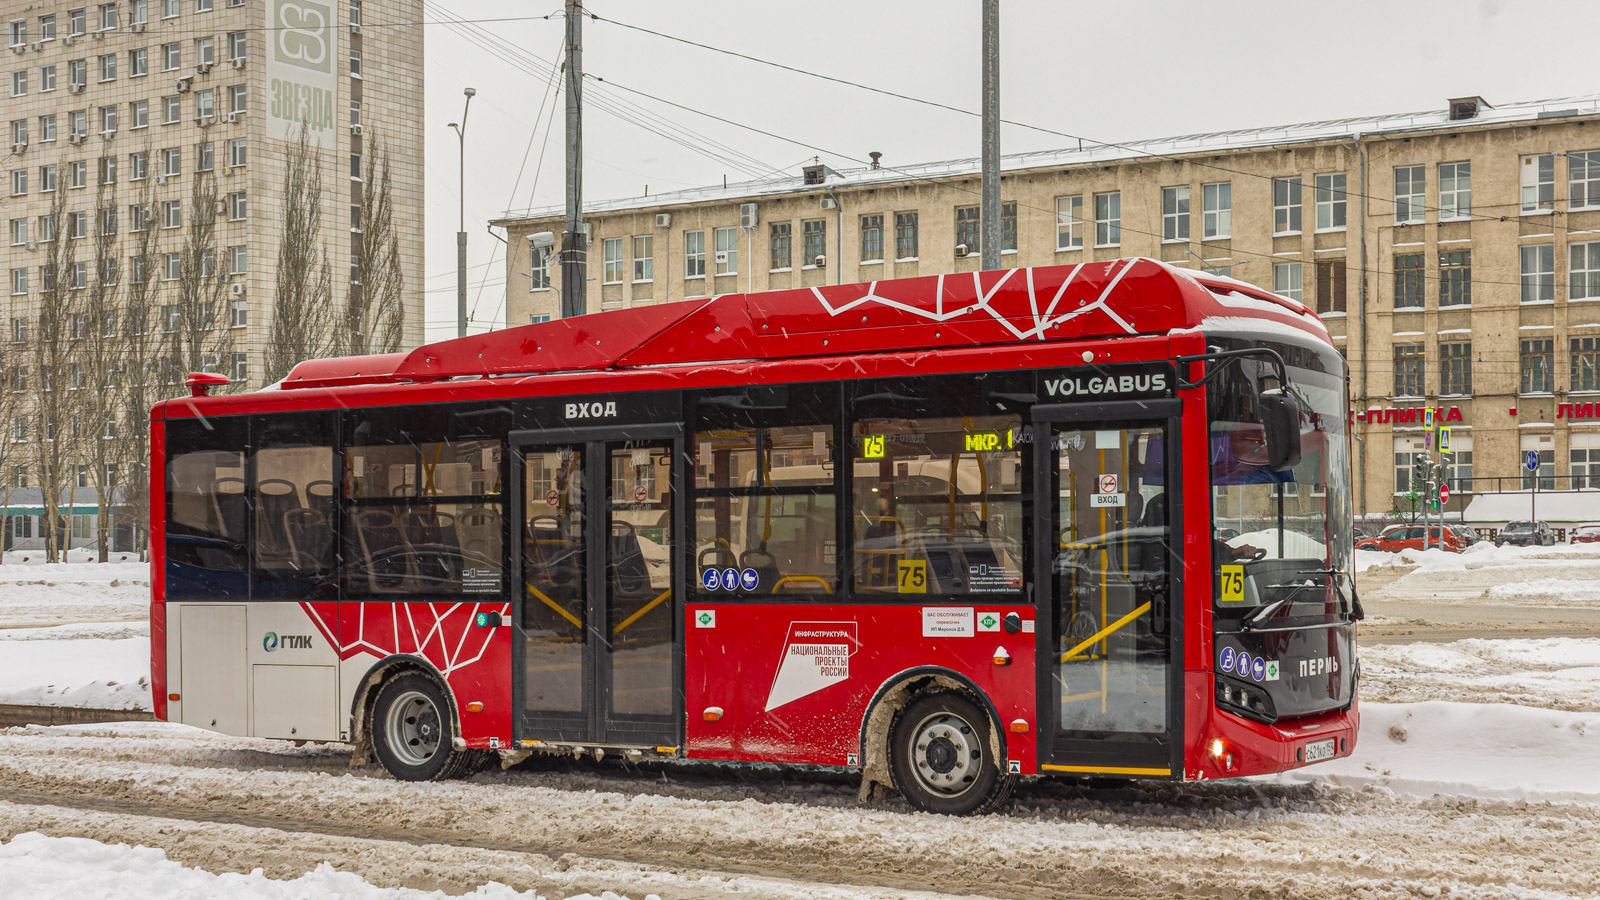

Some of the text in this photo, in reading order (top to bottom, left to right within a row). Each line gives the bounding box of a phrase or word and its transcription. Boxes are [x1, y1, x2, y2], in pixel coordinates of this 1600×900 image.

[271, 78, 333, 132] ЗВЕЗДА
[1044, 373, 1167, 397] VOLGABUS
[565, 401, 617, 419] ВХОД
[864, 435, 885, 457] 75
[1097, 494, 1120, 506] ВХОД
[899, 566, 925, 588] 75
[1222, 571, 1243, 595] 75
[280, 634, 313, 649] ГТЛК
[794, 630, 849, 638] ИНФРАСТРУКТУРА
[790, 645, 847, 656] НАЦИОНАЛЬНЫЕ
[814, 656, 847, 667] ПРОЕКТЫ
[1299, 655, 1339, 678] ПЕРМЬ
[820, 666, 847, 677] РОССИИ
